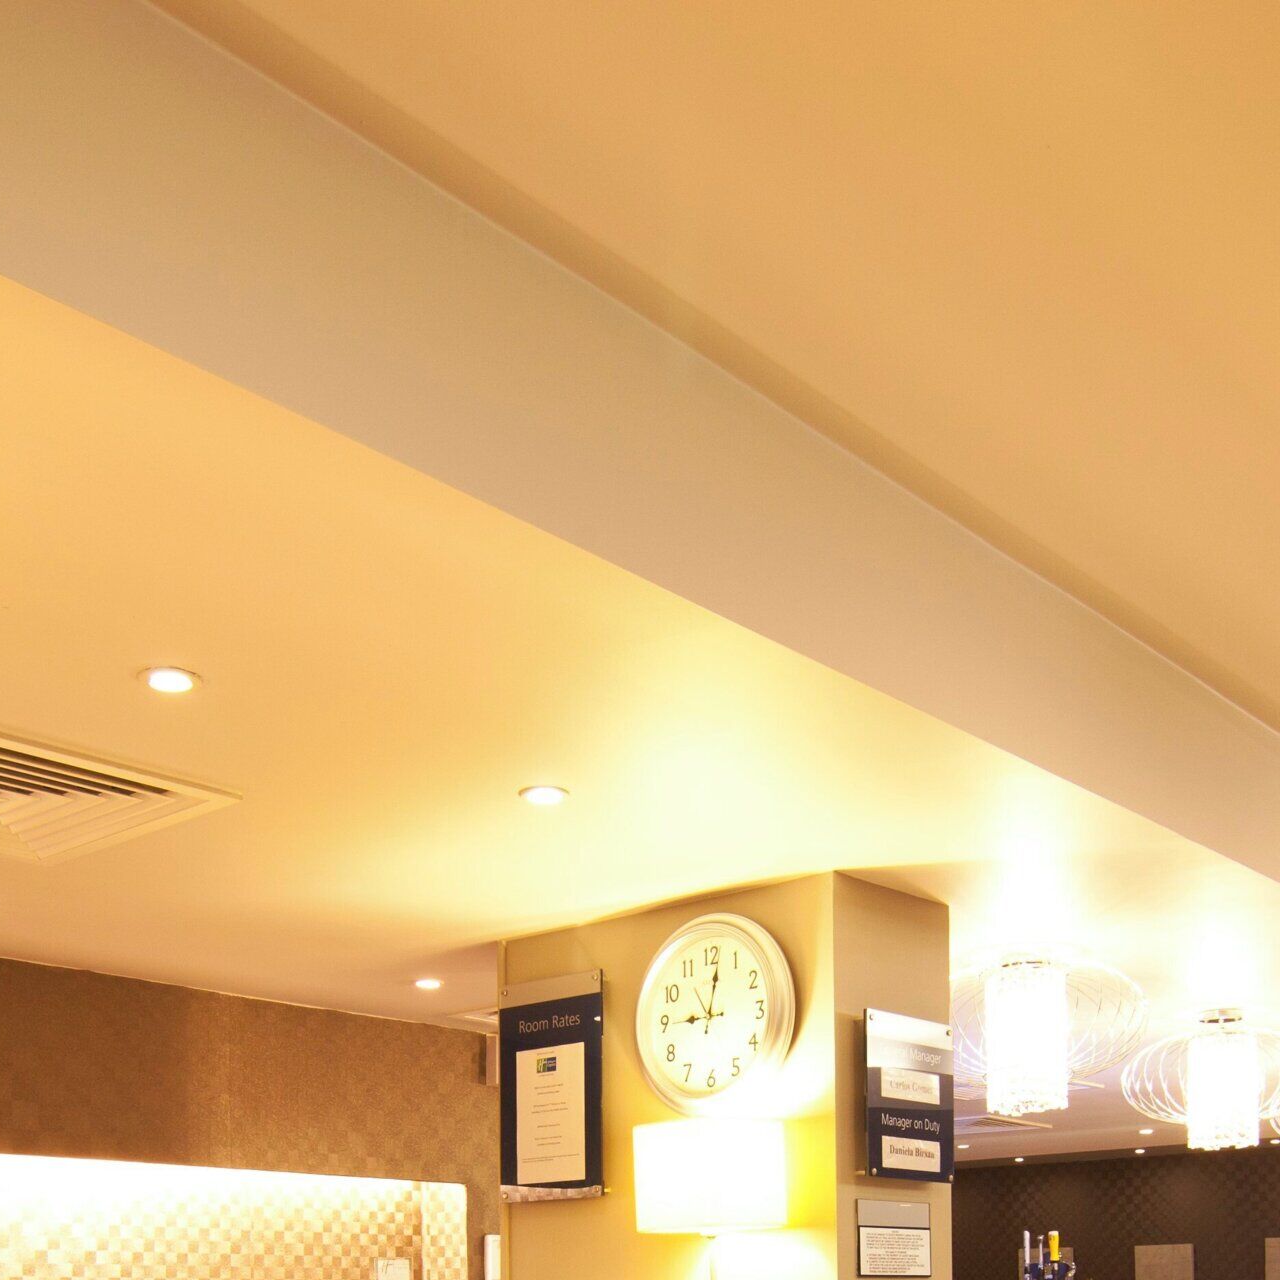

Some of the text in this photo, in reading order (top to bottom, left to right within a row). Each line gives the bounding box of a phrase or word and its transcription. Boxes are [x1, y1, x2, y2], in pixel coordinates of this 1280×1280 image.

[704, 946, 719, 966] 12
[733, 951, 738, 969] 1
[682, 959, 694, 978] 11
[749, 970, 758, 989] 2
[665, 984, 679, 1003] 10
[756, 1000, 765, 1019] 3
[519, 1013, 581, 1034] Room Rates
[660, 1014, 669, 1033] 9
[749, 1033, 759, 1051] 4
[666, 1043, 676, 1062] 8
[911, 1047, 942, 1066] Manager
[683, 1063, 692, 1082] 7
[731, 1057, 740, 1076] 5
[707, 1069, 716, 1088] 6
[881, 1112, 941, 1134] Manager on Duty
[890, 1145, 914, 1157] Daniela
